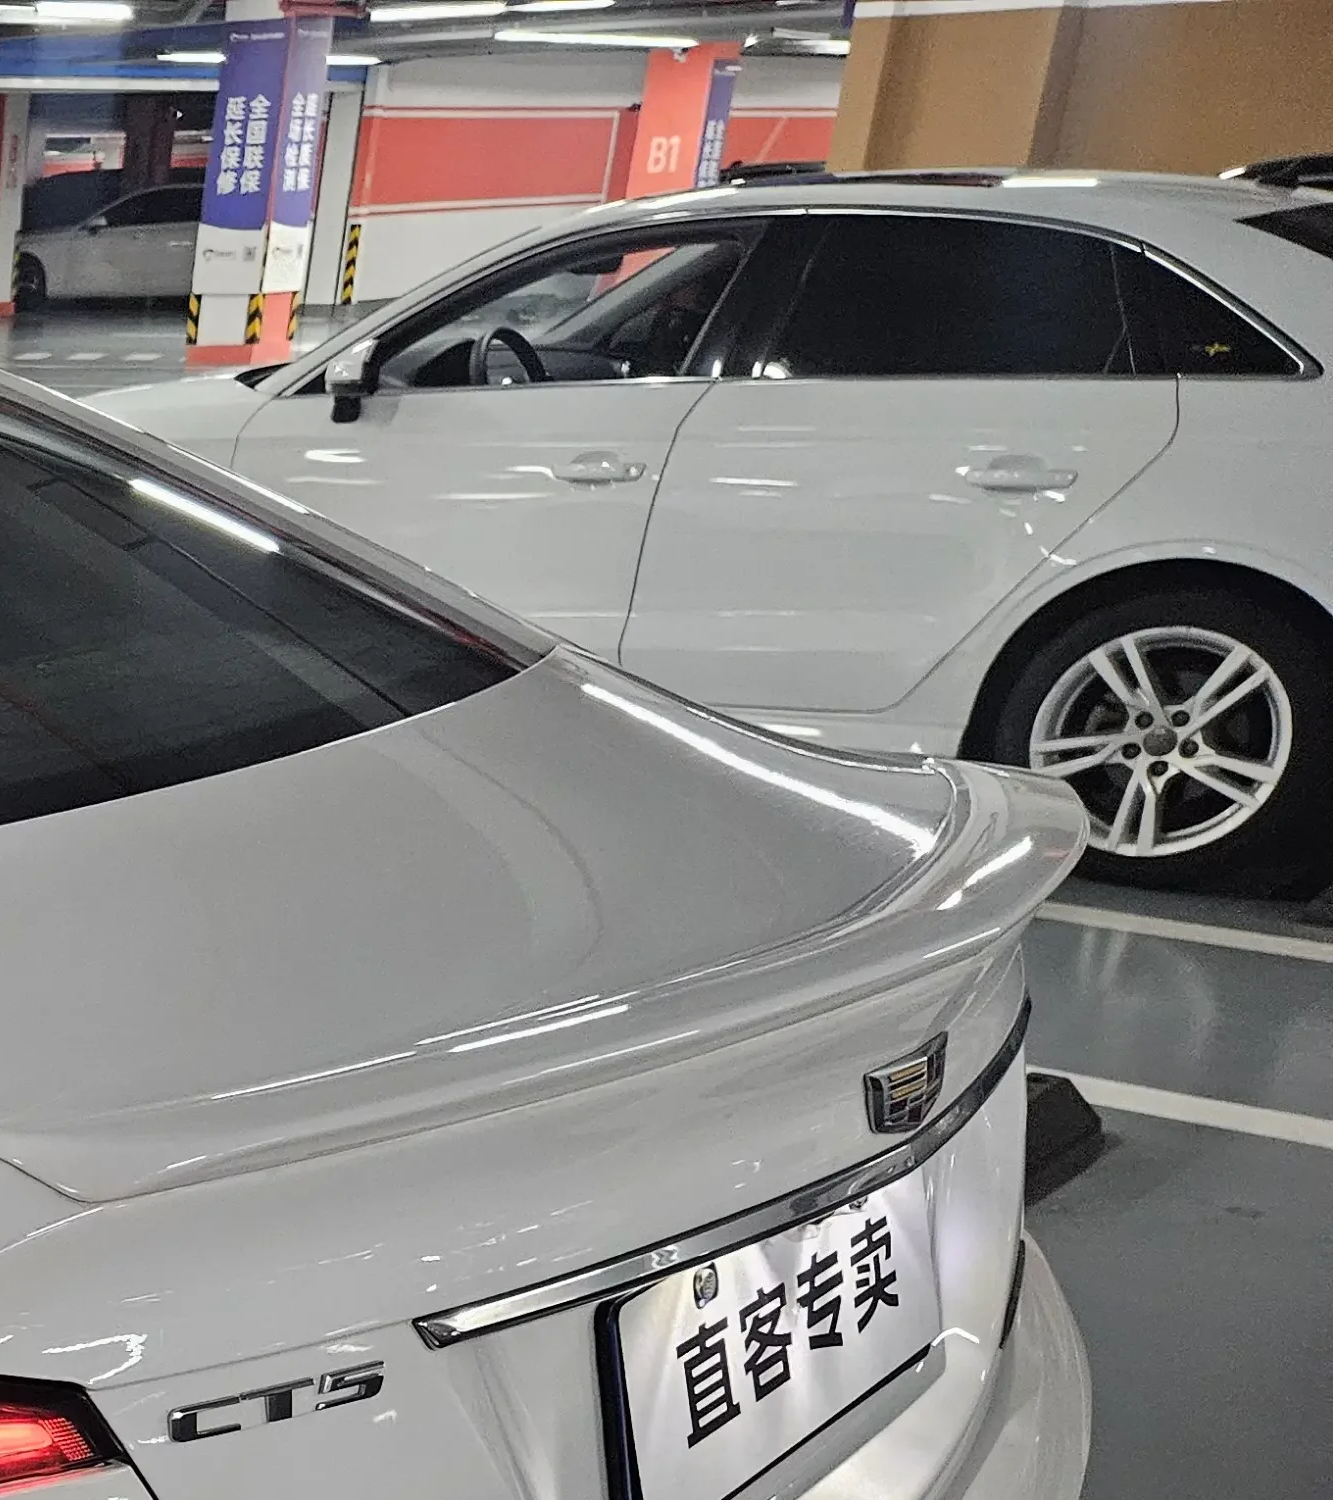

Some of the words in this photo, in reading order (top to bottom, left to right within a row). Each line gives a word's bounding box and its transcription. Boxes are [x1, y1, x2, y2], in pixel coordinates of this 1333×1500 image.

[216, 96, 247, 196] 延长保修
[239, 93, 272, 195] 全国联保
[647, 135, 681, 174] B1
[675, 1215, 900, 1450] 直客专卖
[166, 1359, 385, 1443] CT5
